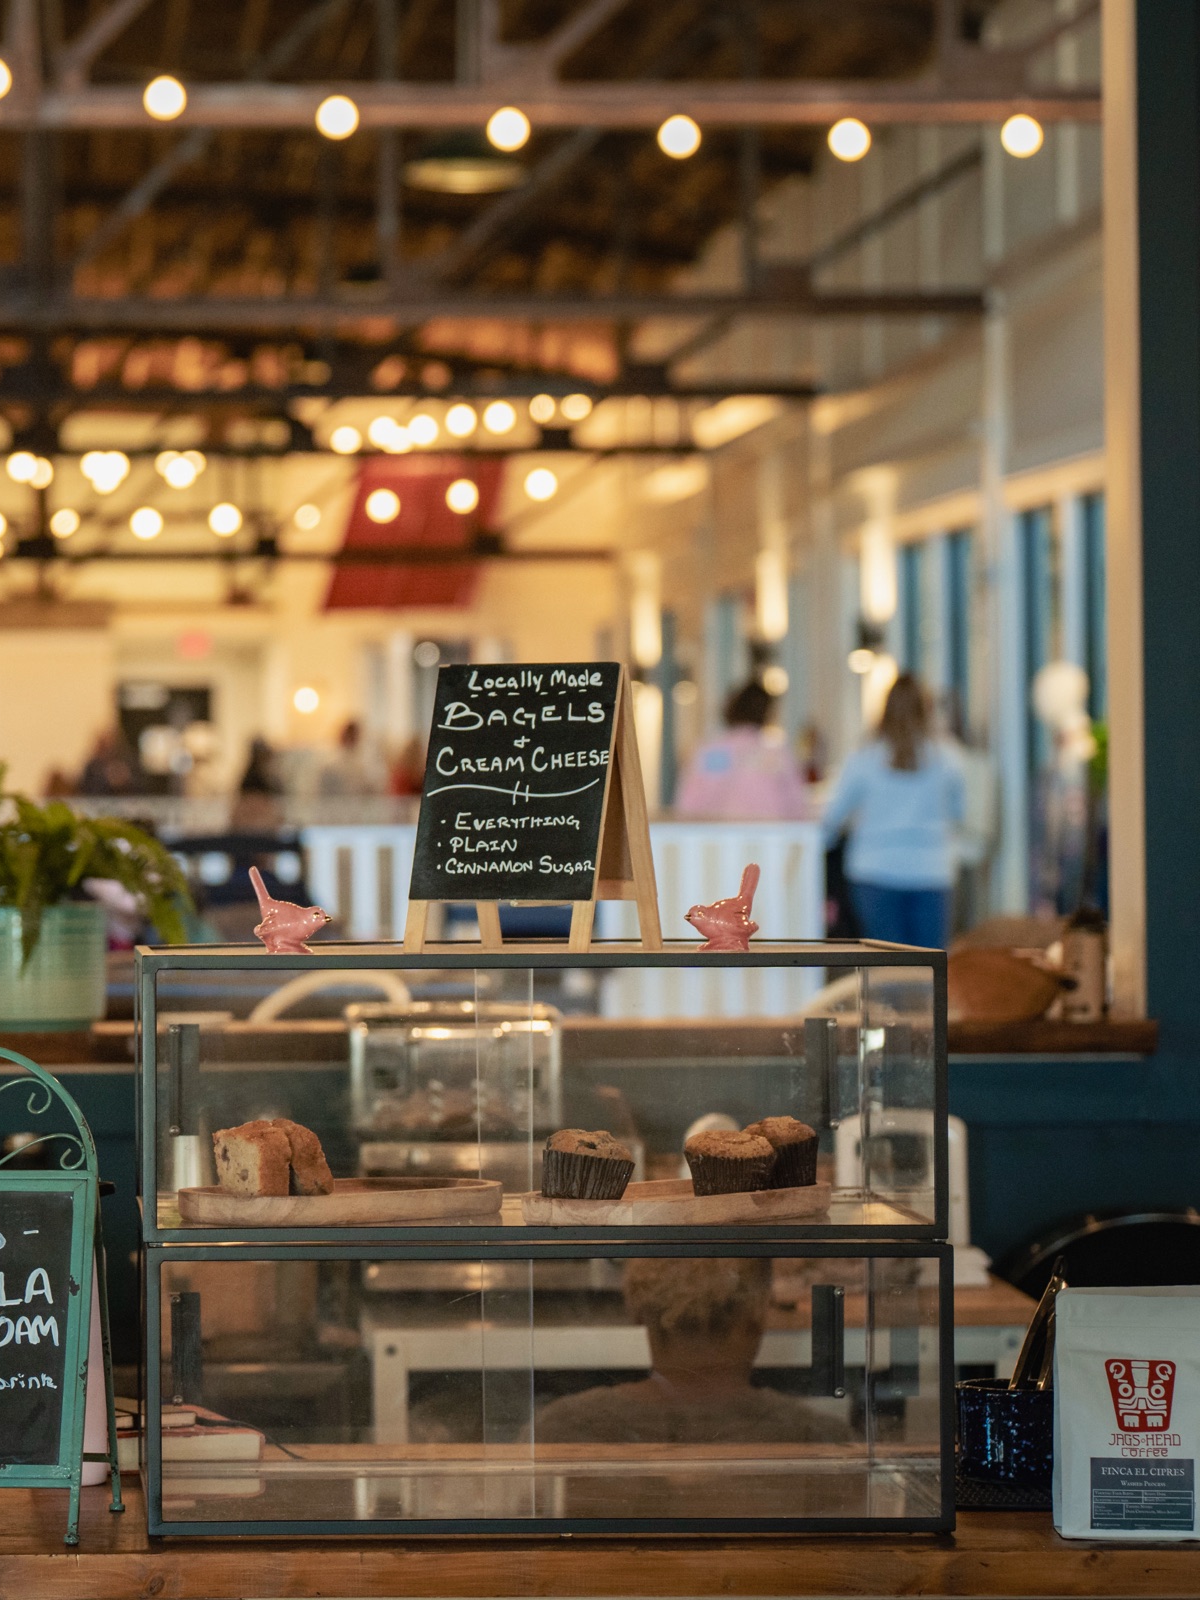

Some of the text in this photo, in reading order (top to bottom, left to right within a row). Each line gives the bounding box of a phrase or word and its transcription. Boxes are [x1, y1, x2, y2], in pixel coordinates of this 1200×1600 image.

[468, 669, 603, 692] Locally Made
[438, 701, 606, 730] BAGELS
[436, 746, 609, 776] CREAM CHEESE
[455, 812, 580, 830] EVERYTHING
[450, 836, 518, 853] PLAIN
[445, 855, 595, 875] CINNAMON SUGAR
[1101, 1466, 1185, 1477] FINCA EL CIPRES
